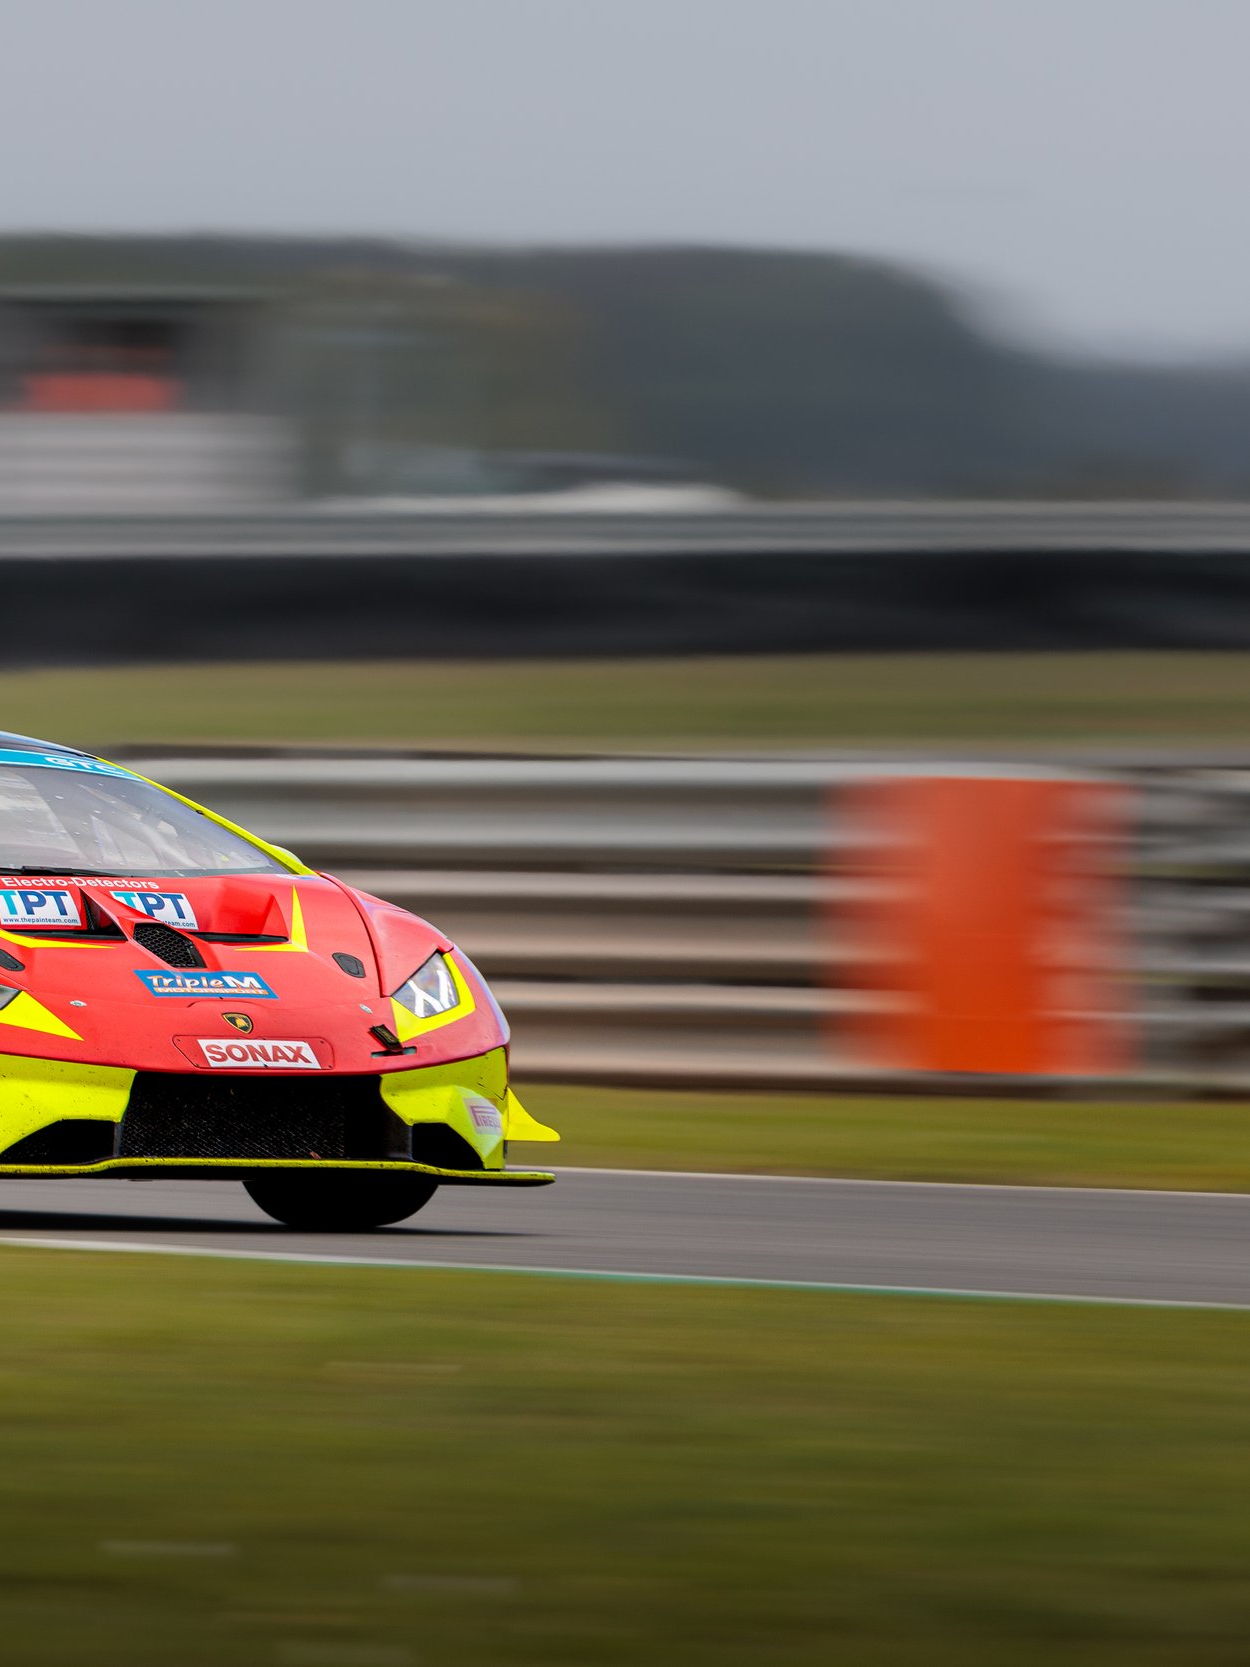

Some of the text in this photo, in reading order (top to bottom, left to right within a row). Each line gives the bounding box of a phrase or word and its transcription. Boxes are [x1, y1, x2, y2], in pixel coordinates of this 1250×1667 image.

[0, 877, 160, 890] Electro-Detectors
[110, 891, 186, 920] TPT
[3, 916, 80, 925] www.thepainteam.com
[205, 1044, 313, 1064] SONAX
